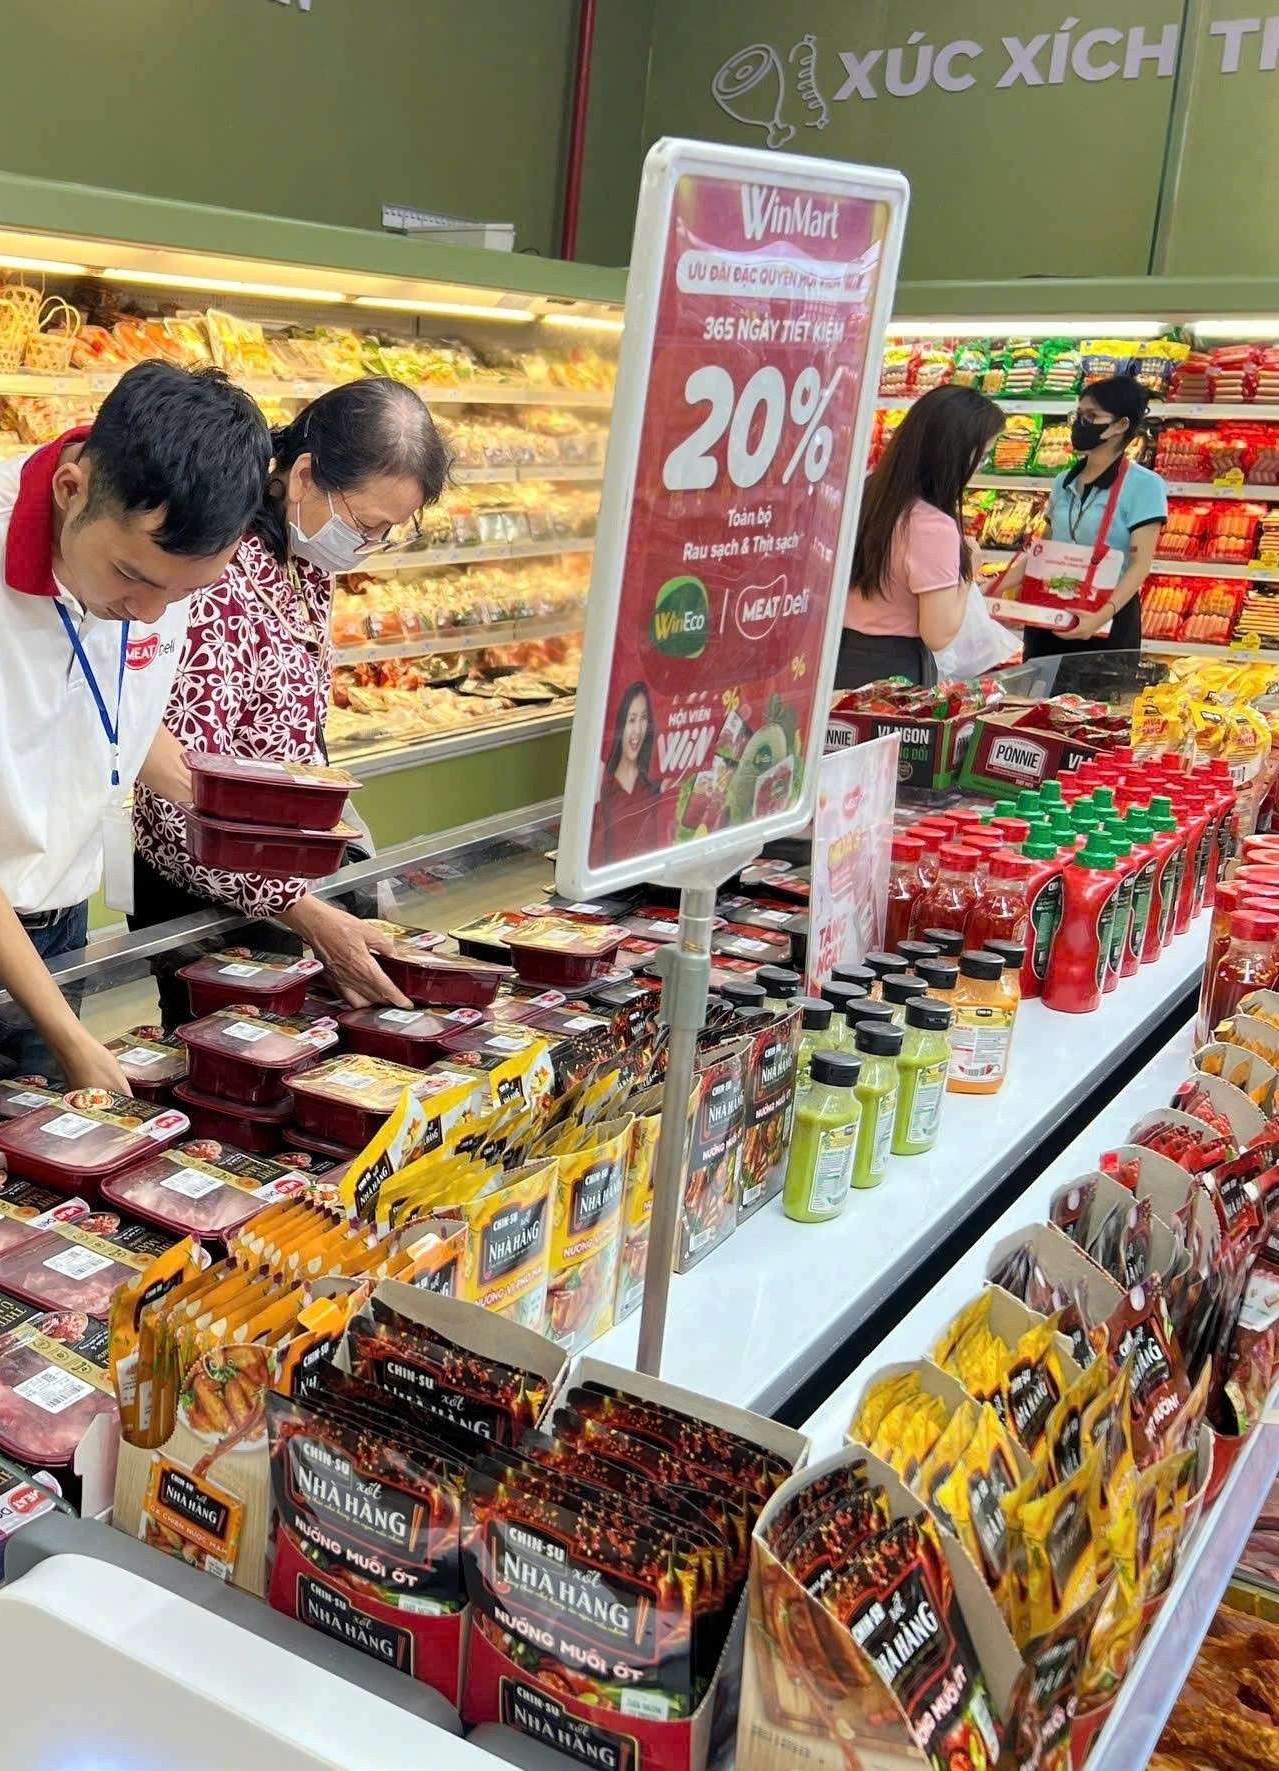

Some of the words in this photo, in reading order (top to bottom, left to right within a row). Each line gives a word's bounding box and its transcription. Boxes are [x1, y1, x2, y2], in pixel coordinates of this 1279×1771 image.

[833, 31, 985, 102] XÚC
[994, 17, 1180, 89] XÍCH
[741, 183, 841, 241] WinMart
[703, 316, 736, 341] 365
[737, 313, 780, 342] NGÀY
[781, 314, 811, 343] TIẾT
[662, 365, 843, 491] 20%
[727, 507, 756, 527] Toàn
[756, 506, 772, 526] bộ
[683, 543, 708, 562] Rau
[710, 541, 739, 561] sạch
[741, 540, 750, 554] &
[752, 535, 774, 557] Thịt
[775, 533, 799, 556] sạch
[742, 596, 781, 624] MEAT
[783, 588, 811, 619] Deli
[654, 610, 706, 641] WinEco
[126, 645, 156, 661] MEAT
[668, 711, 690, 728] HỘI
[691, 707, 711, 726] VIÊN
[826, 729, 852, 746] NNIE
[493, 1211, 518, 1231] CHIN-SU
[489, 1236, 512, 1263] NHÀ
[513, 1220, 539, 1251] HÀNG
[303, 1341, 330, 1368] CHIN-SU
[387, 1362, 434, 1390] CHIN-SU
[441, 1394, 465, 1412] xốt
[303, 1442, 350, 1476] CHIN-SU
[170, 1473, 194, 1491] CHIN-SU
[356, 1481, 384, 1500] xốt
[167, 1485, 187, 1507] NHÀ
[188, 1500, 217, 1524] HÀNG
[298, 1466, 341, 1508] NHÀ
[345, 1493, 406, 1537] HÀNG
[295, 1515, 342, 1555] NƯỚNG
[346, 1548, 386, 1578] MUỐI
[392, 1567, 418, 1587] ỚT
[509, 1527, 565, 1562] CHIN-SU
[504, 1551, 554, 1595] NHÀ
[559, 1581, 629, 1630] HÀNG
[572, 1568, 602, 1589] xốt
[310, 1582, 347, 1610] CHIN-SU
[308, 1598, 342, 1631] NHÀ
[345, 1622, 393, 1658] HÀNG
[894, 1600, 939, 1662] HÀNG
[495, 1607, 555, 1648] NƯỚNG
[560, 1639, 607, 1673] MUỐI
[613, 1662, 644, 1681] ỚT
[516, 1686, 560, 1716] CHIN-SU
[514, 1703, 555, 1738] NHÀ
[558, 1728, 615, 1767] HÀNG
